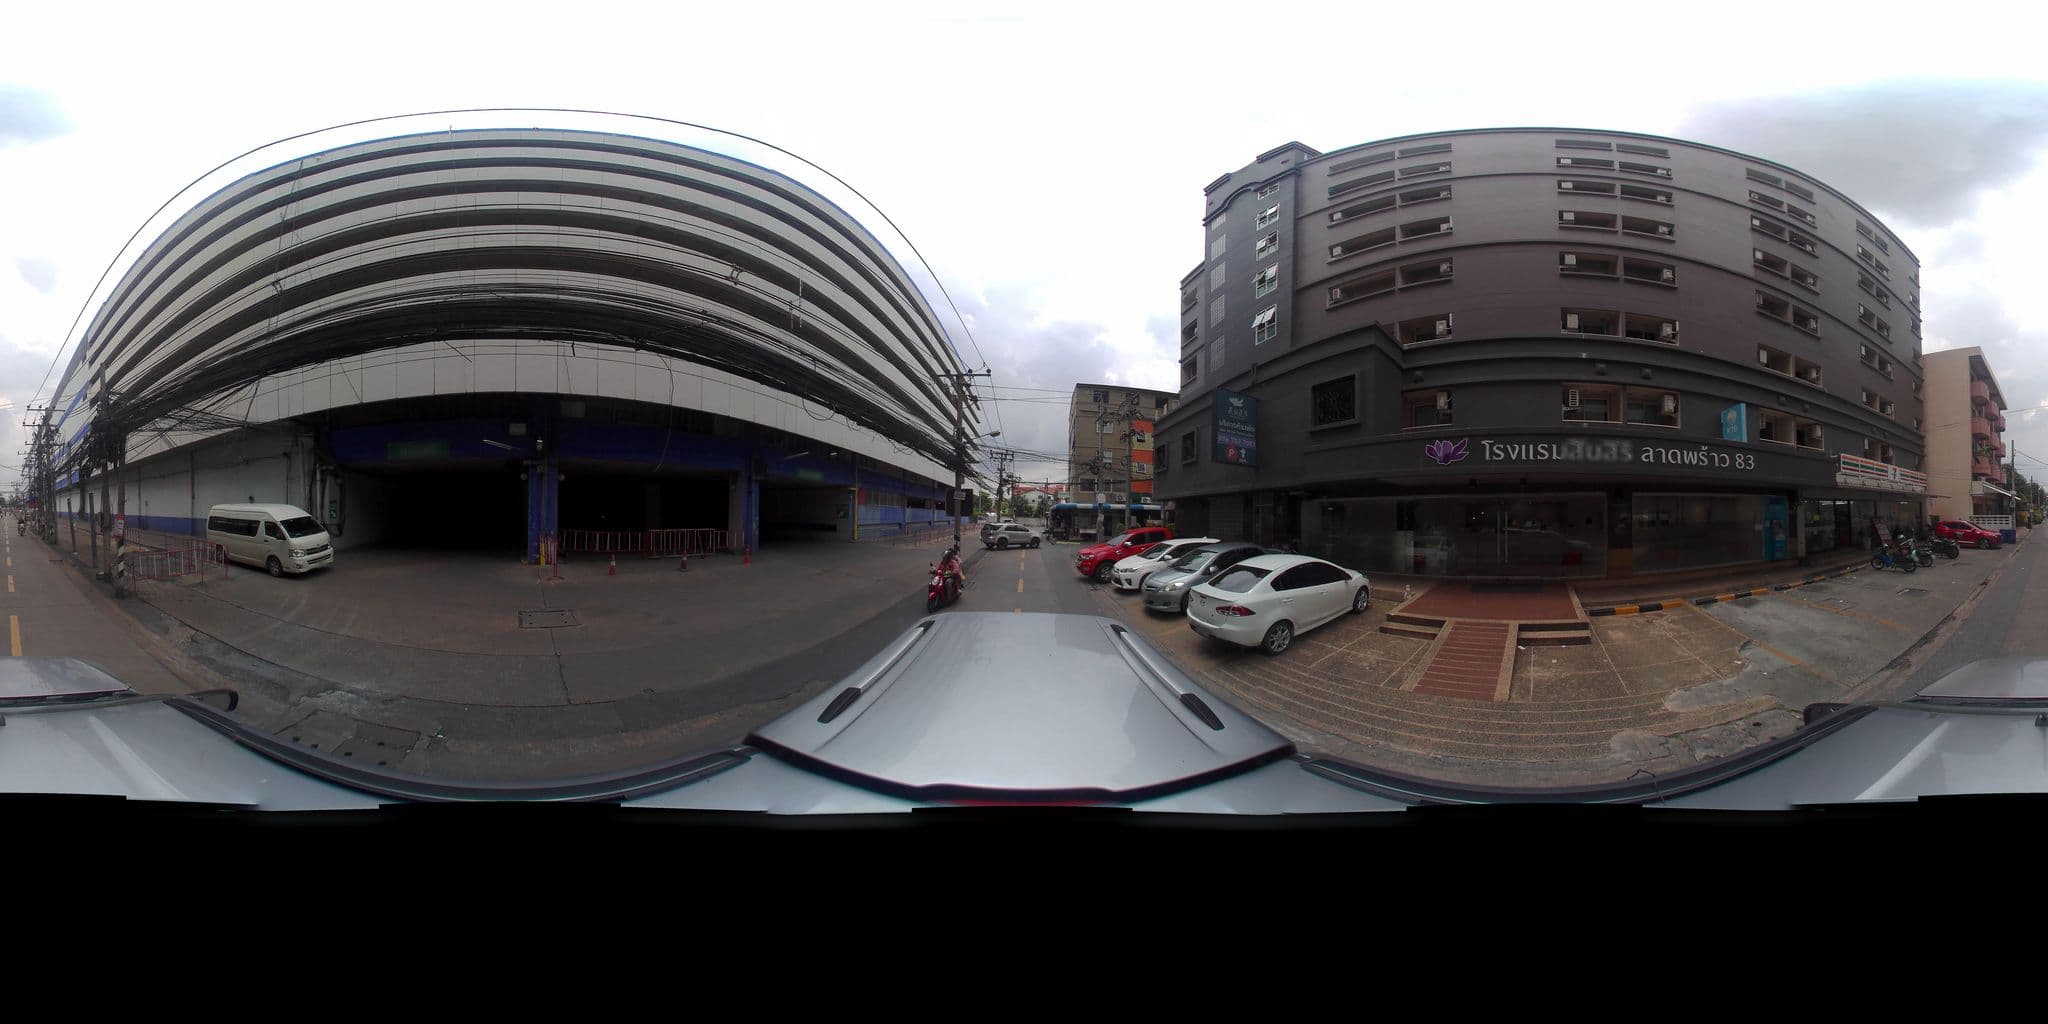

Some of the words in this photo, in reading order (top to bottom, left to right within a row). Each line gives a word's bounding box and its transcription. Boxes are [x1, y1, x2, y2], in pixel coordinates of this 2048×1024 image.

[1640, 445, 1730, 467] ลาดพร้าว
[1735, 453, 1755, 470] 83
